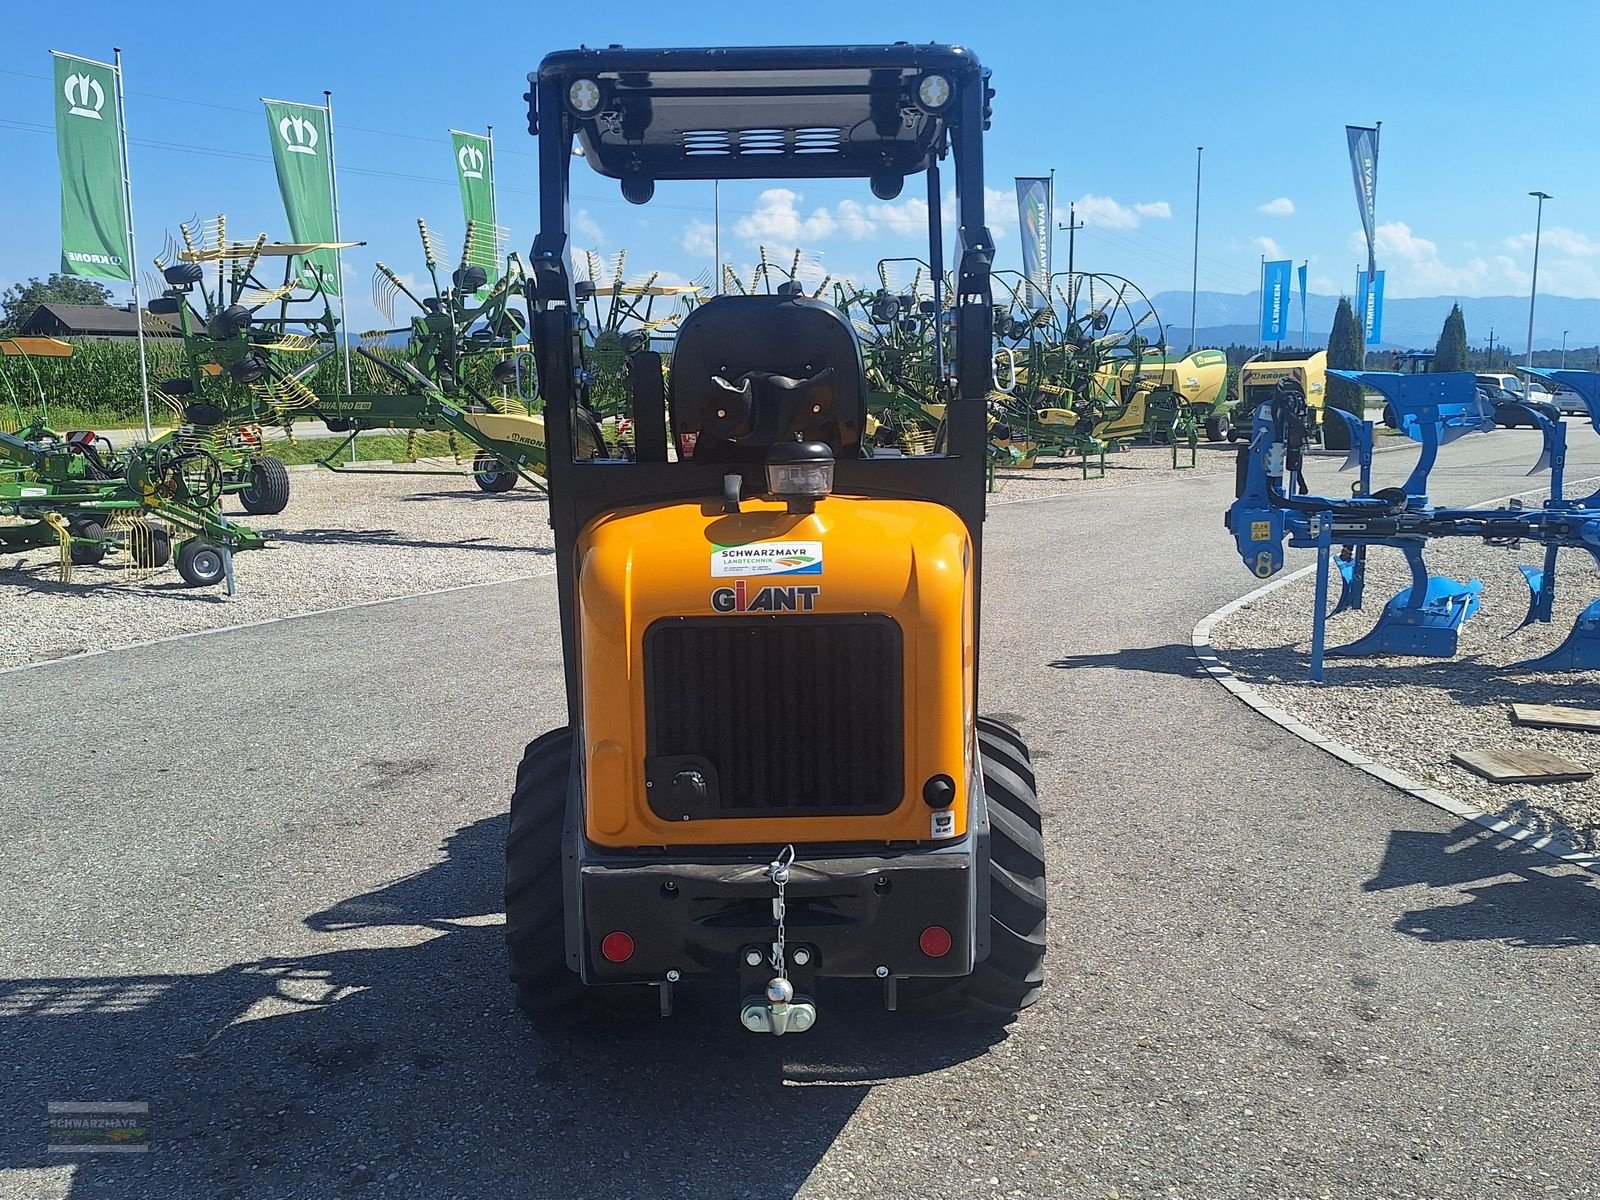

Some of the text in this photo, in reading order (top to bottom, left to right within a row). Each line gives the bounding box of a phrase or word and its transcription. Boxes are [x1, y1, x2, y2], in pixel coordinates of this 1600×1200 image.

[1272, 282, 1282, 324] LEMKEN
[1366, 292, 1376, 329] LEMKEN
[722, 548, 806, 557] SCHWARZMAYR
